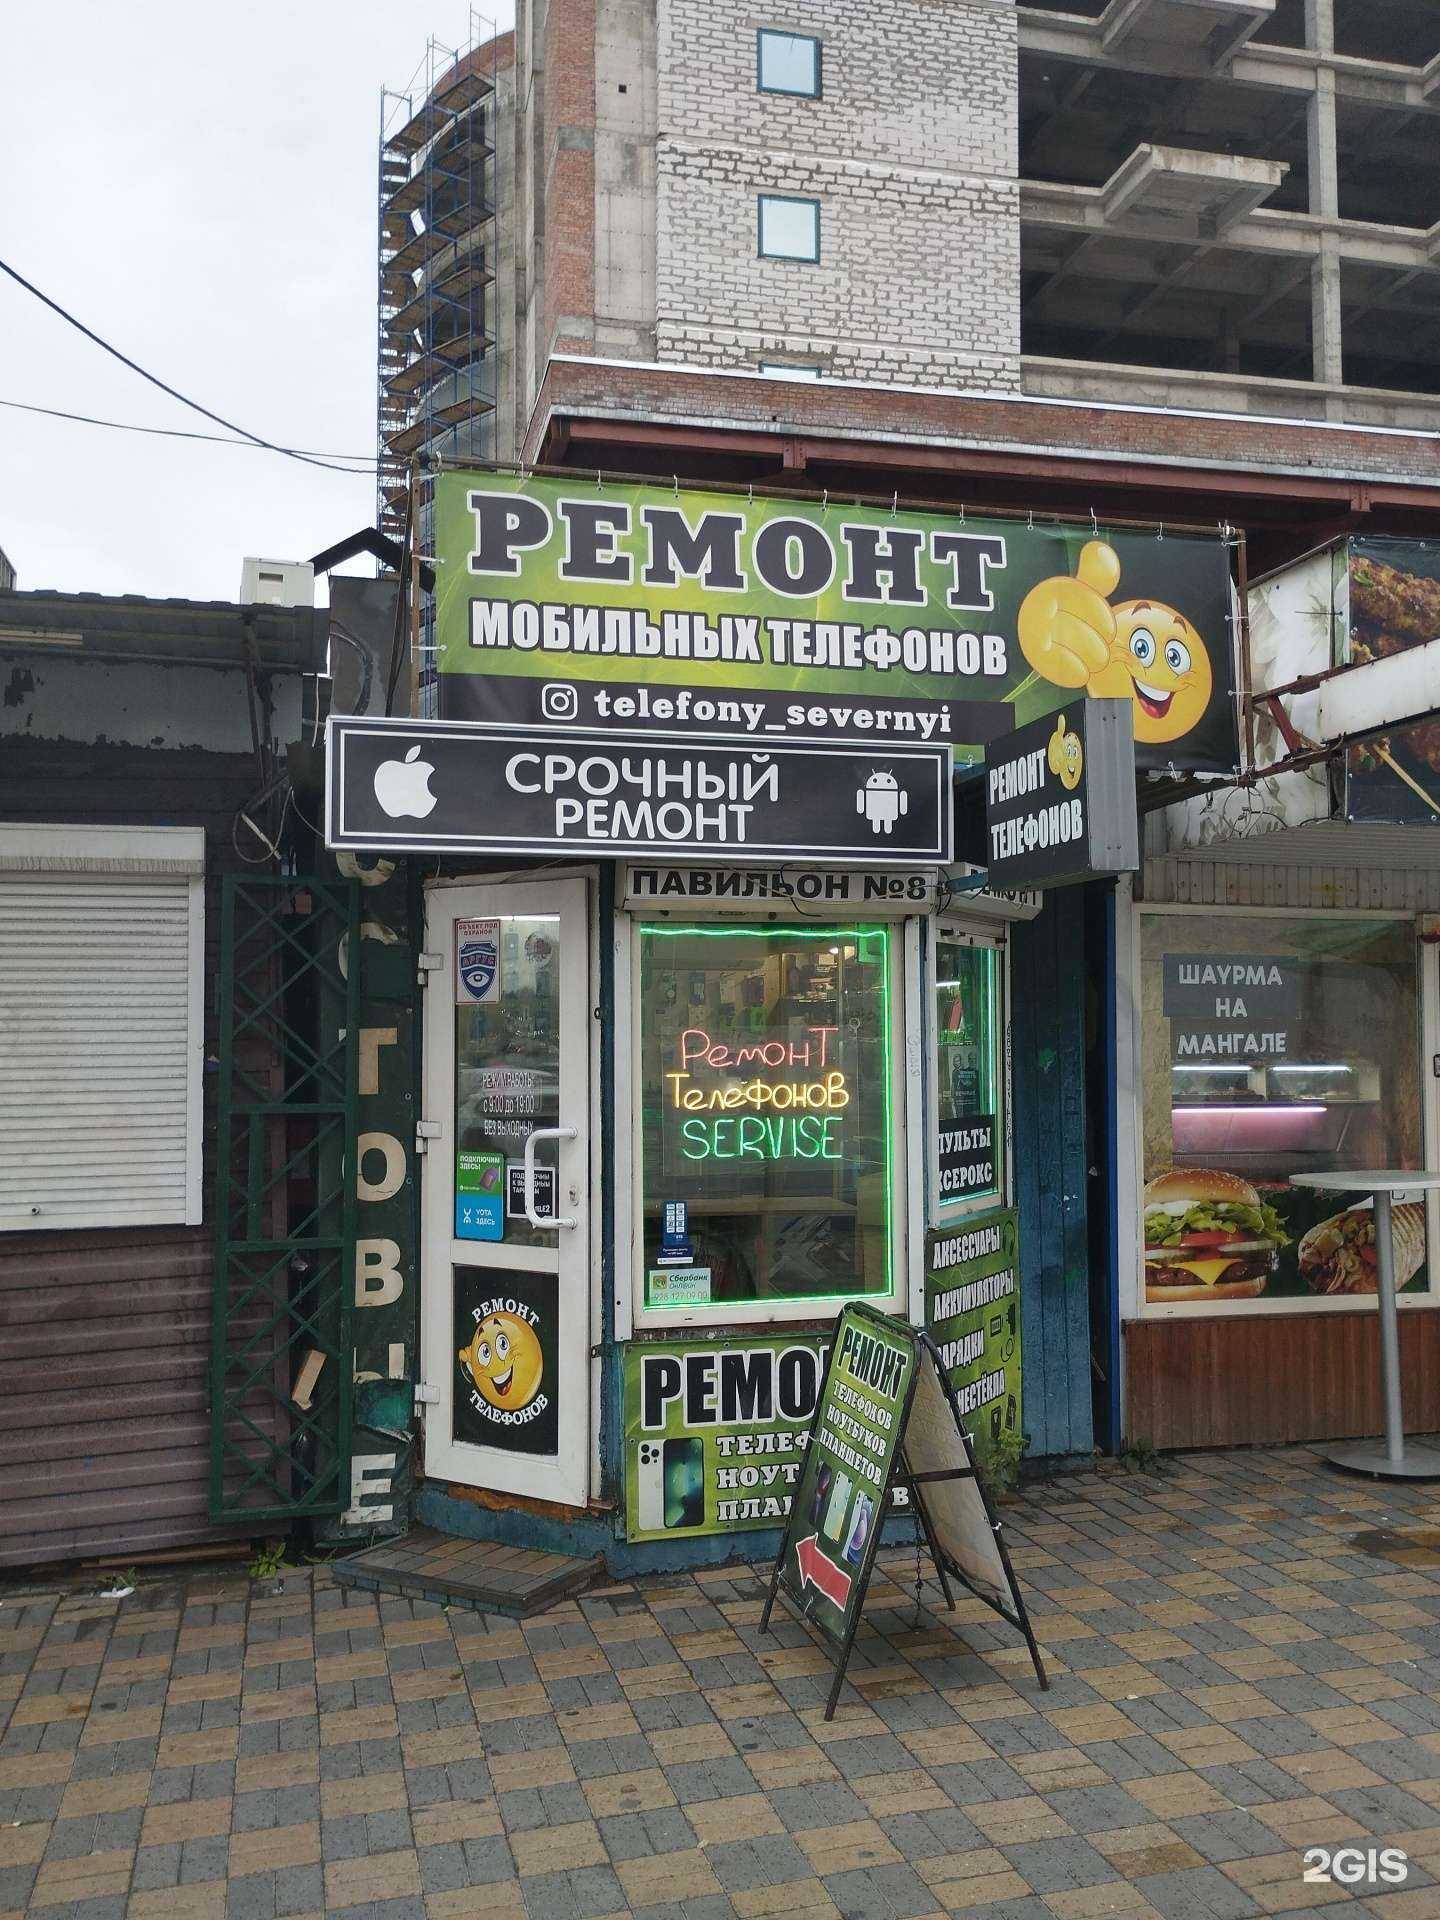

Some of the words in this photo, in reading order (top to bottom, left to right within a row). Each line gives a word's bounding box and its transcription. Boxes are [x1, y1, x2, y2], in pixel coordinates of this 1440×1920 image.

[466, 489, 1008, 612] РЕМОНТ
[470, 600, 762, 664] МОБИЛЬНЫХ
[771, 622, 1008, 676] ТЕЛЕФОНОВ
[594, 688, 953, 738] telefony_severnyi
[505, 753, 780, 803] СРОЧНЫЙ
[989, 747, 1047, 807] РЕМОНТ
[556, 799, 754, 844] РЕМОНТ
[990, 797, 1084, 862] ТЕЛЕФОНОВ
[632, 870, 849, 898] ПАВИЛЬОН
[864, 875, 927, 901] №8
[1178, 964, 1283, 986] ШАУРМА
[1215, 998, 1248, 1018] НА
[1177, 1032, 1287, 1055] МАНГАЛЕ
[484, 1120, 496, 1135] БЕЗ
[497, 1120, 534, 1138] ВЫХОДНЫХ
[505, 1099, 514, 1115] до
[682, 1116, 843, 1160] SERVISE
[932, 1225, 1000, 1270] АКСЕССУАРЫ
[471, 1297, 541, 1327] РЕМОНТ
[933, 1268, 1014, 1322] АККУМУЛЯТОРЫ
[837, 1324, 908, 1401] РЕМОНТ
[468, 1389, 550, 1426] ТЕЛЕФОНОВ
[640, 1346, 829, 1431] РЕМО
[833, 1381, 893, 1430] ТЕЛЕФОНОВ
[827, 1404, 887, 1457] НОУТБУКОВ
[819, 1428, 882, 1486] ПЛАНШЕТОВ
